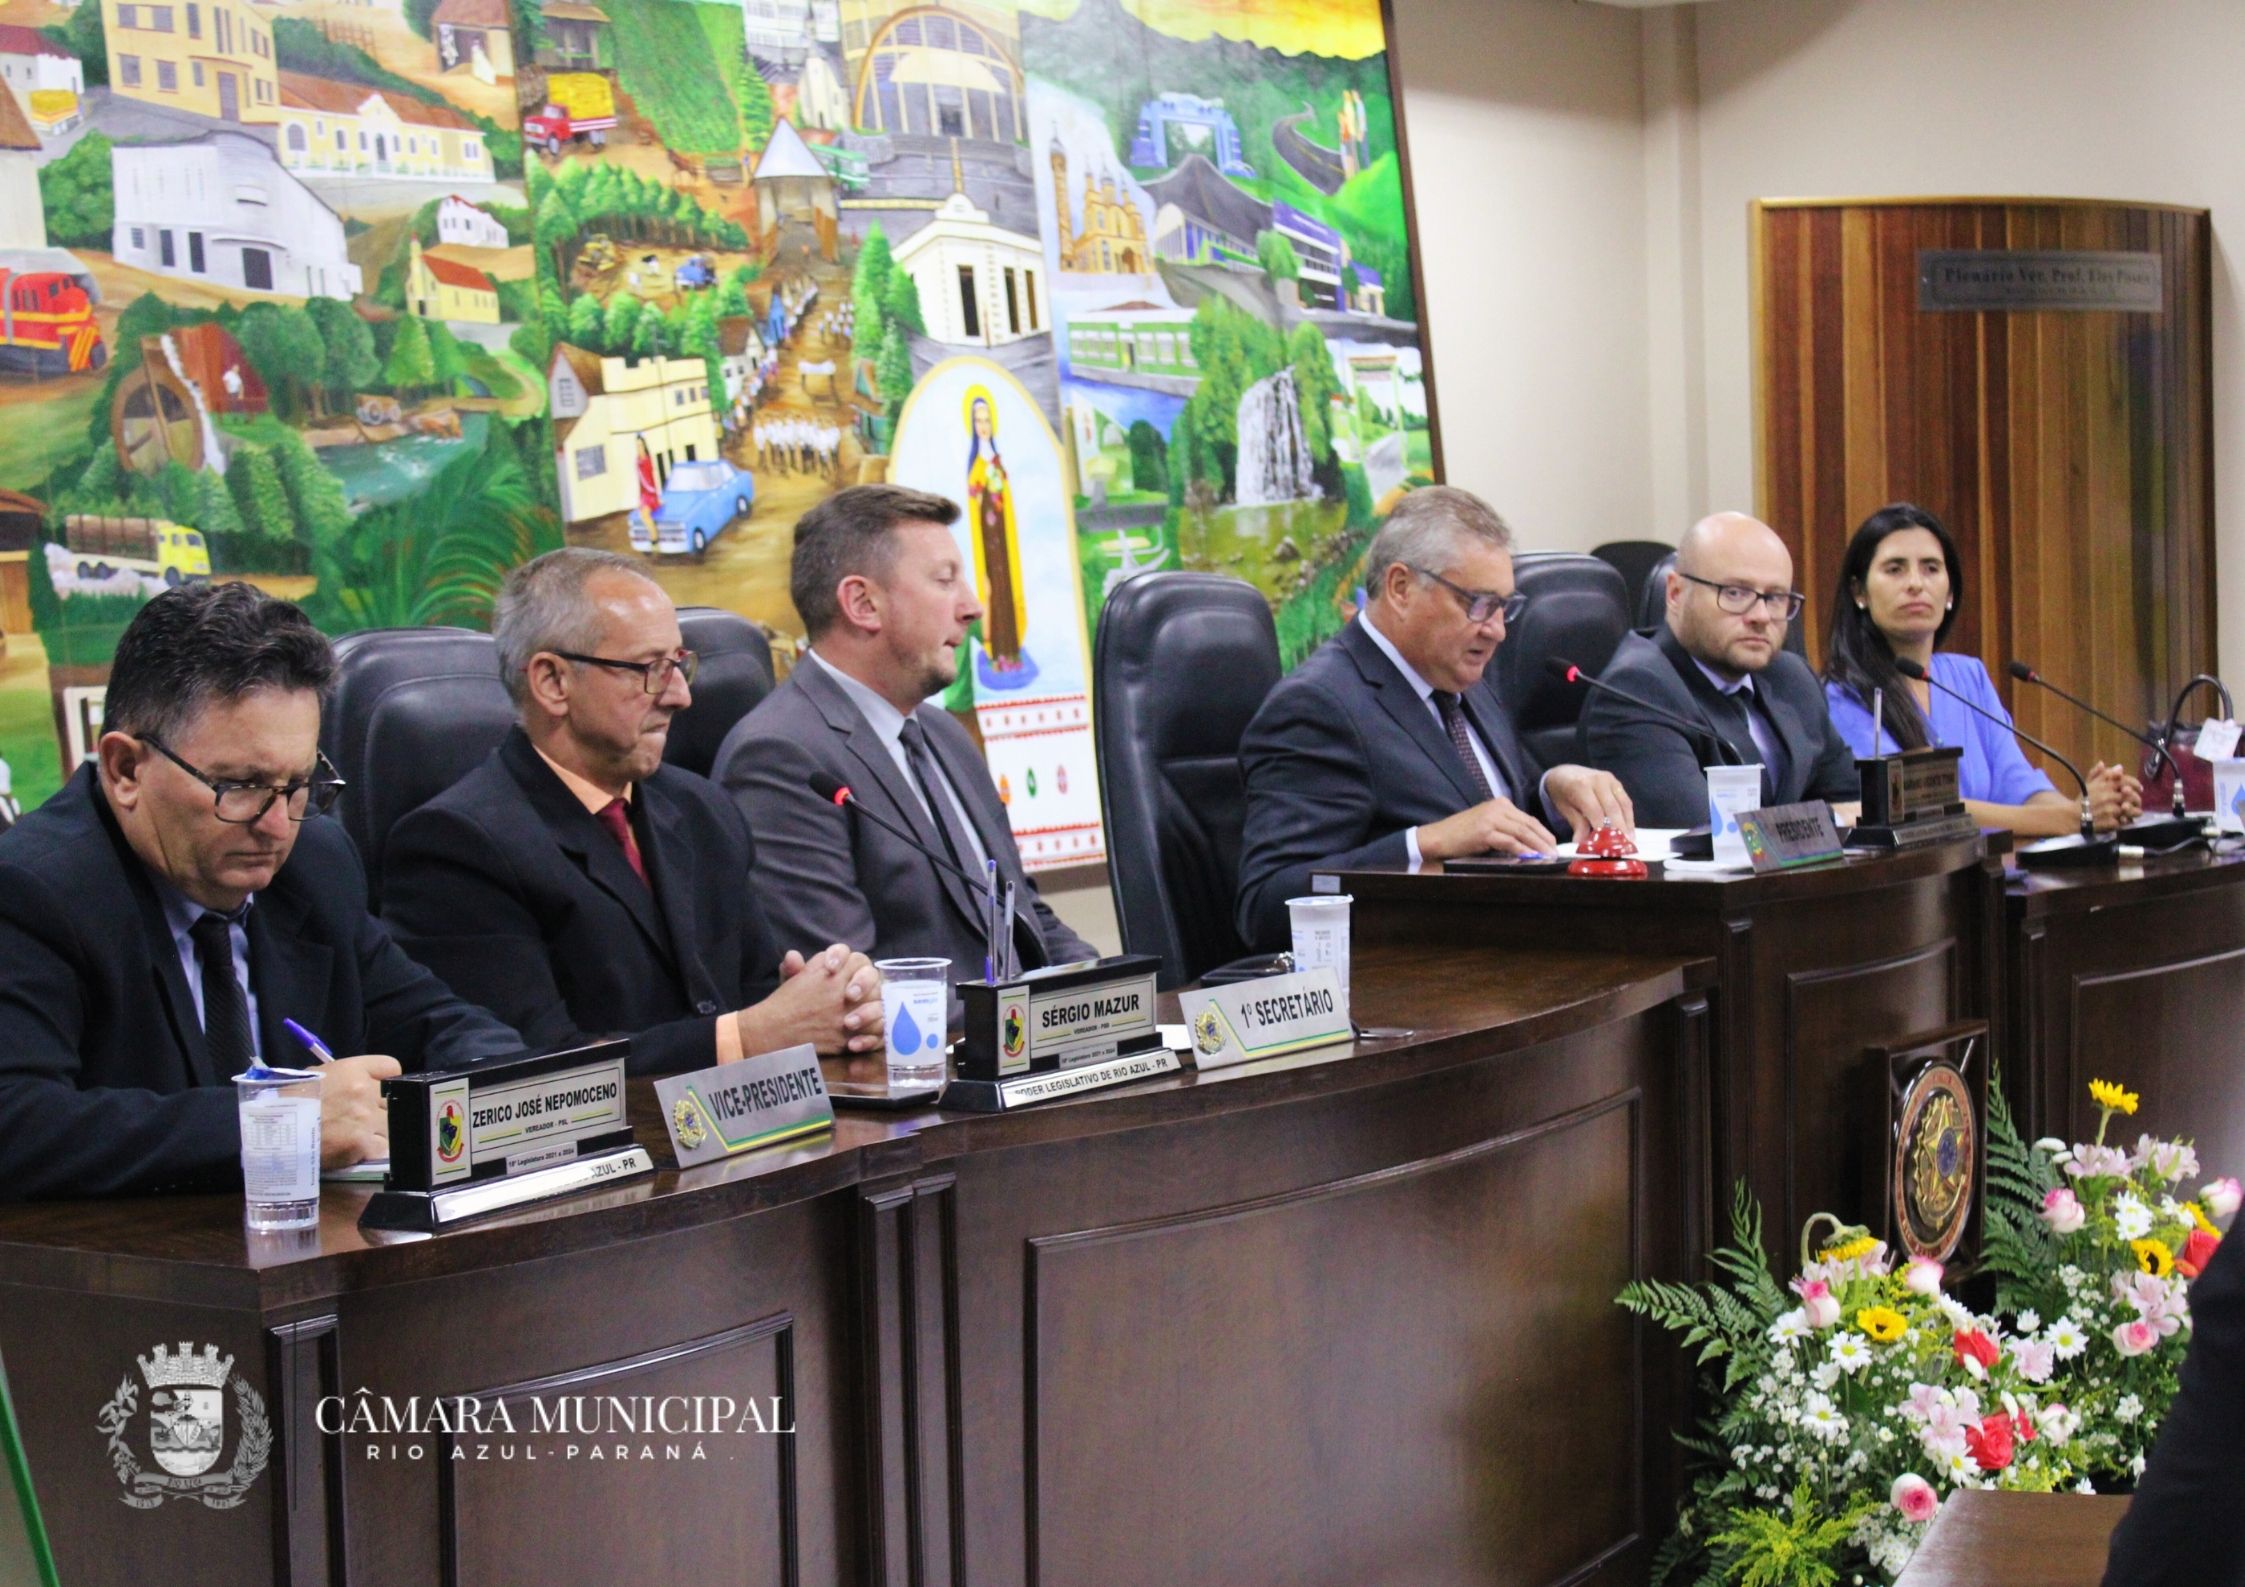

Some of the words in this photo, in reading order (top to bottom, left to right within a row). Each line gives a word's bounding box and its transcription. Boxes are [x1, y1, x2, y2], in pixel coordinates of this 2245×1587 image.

[1042, 1004, 1090, 1028] SÉRGIO
[1094, 993, 1139, 1018] MAZUR
[1255, 986, 1334, 1026] SECRETÁRIO
[1046, 1073, 1099, 1092] LEGISLATIVO
[1101, 1071, 1112, 1081] DE
[1113, 1066, 1128, 1078] RIO
[1129, 1063, 1151, 1075] AZUL
[1156, 1058, 1168, 1069] PR
[472, 1105, 512, 1128] ZERICO
[515, 1094, 542, 1118] JOSÉ
[545, 1082, 617, 1112] NEPOMOCENO
[708, 1067, 822, 1121] VICE-PRESIDENTE
[525, 1121, 554, 1133] VEREADOR
[622, 1157, 637, 1170] PR
